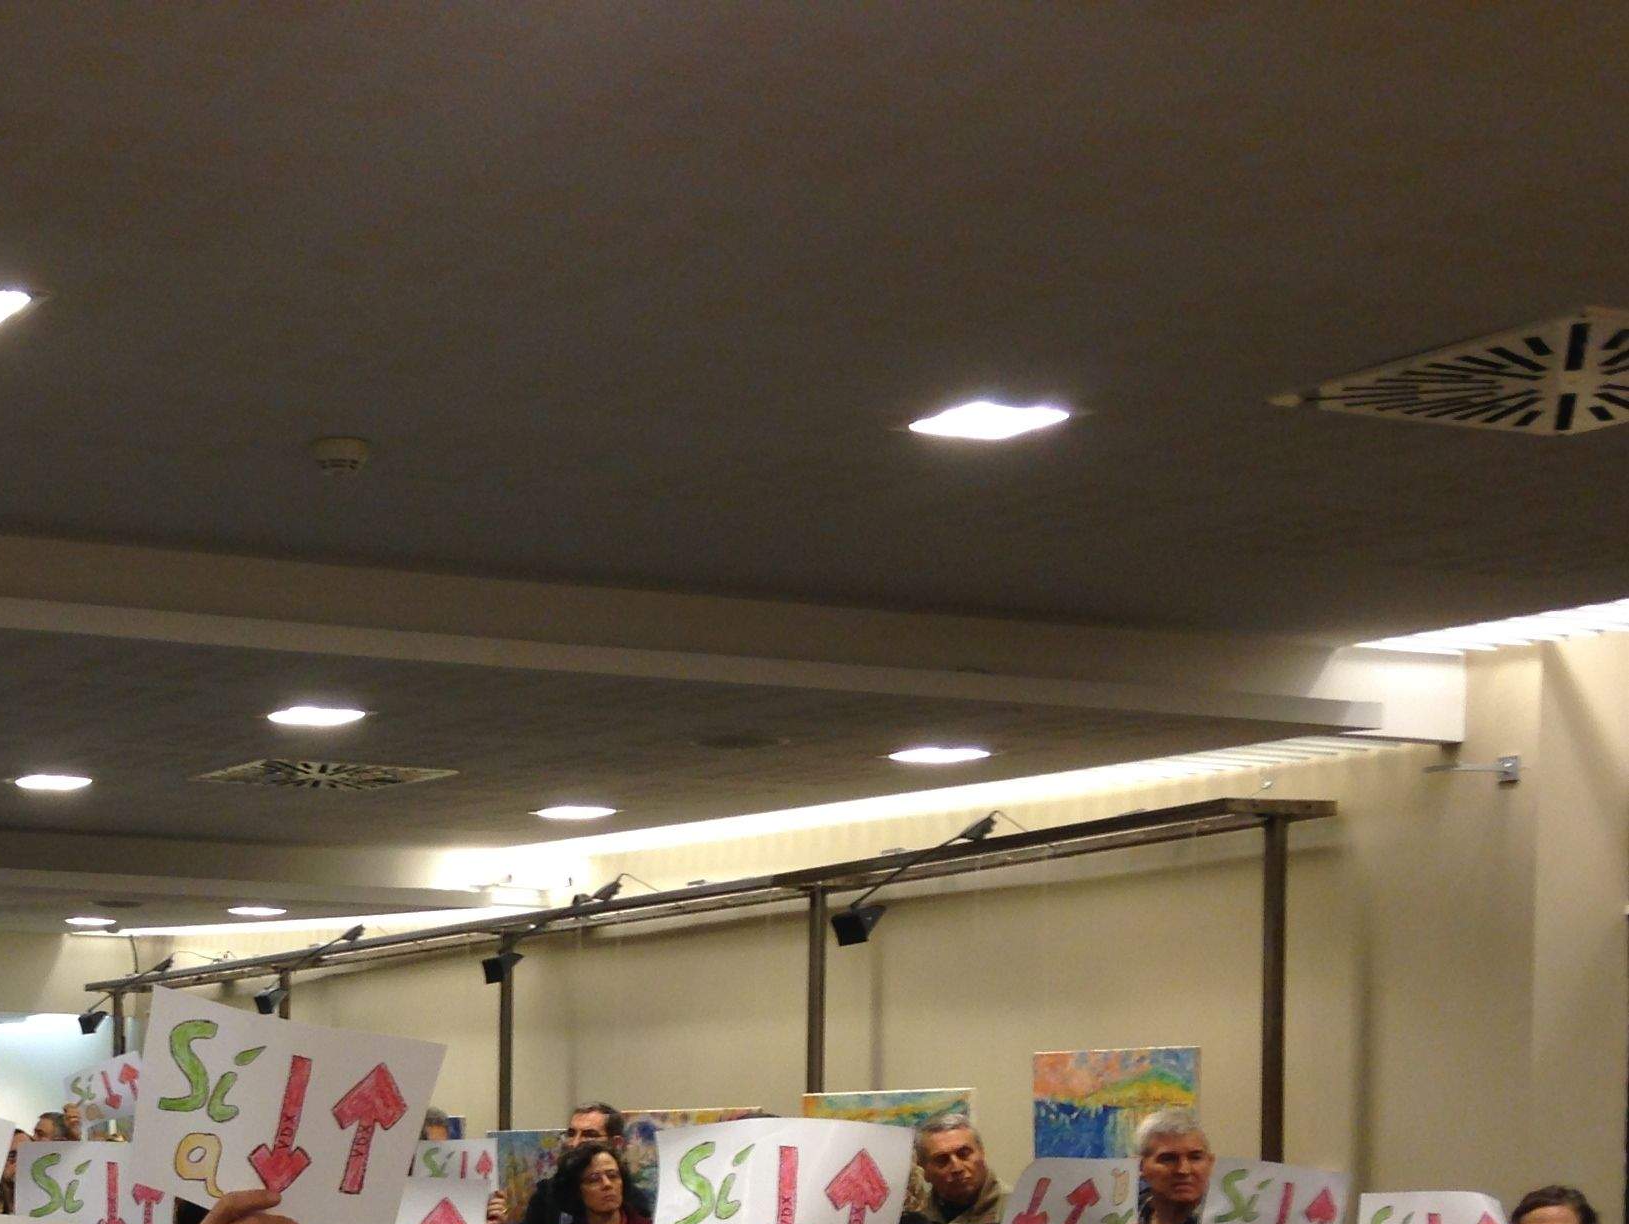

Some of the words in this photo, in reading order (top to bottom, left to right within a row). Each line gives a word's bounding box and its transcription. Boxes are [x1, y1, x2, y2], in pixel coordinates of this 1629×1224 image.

[159, 1019, 267, 1123] Sí
[276, 1115, 296, 1150] VDX
[349, 1125, 373, 1158] VDX
[29, 1152, 91, 1218] Sí
[175, 1132, 225, 1198] a
[1214, 1168, 1273, 1224] Sí
